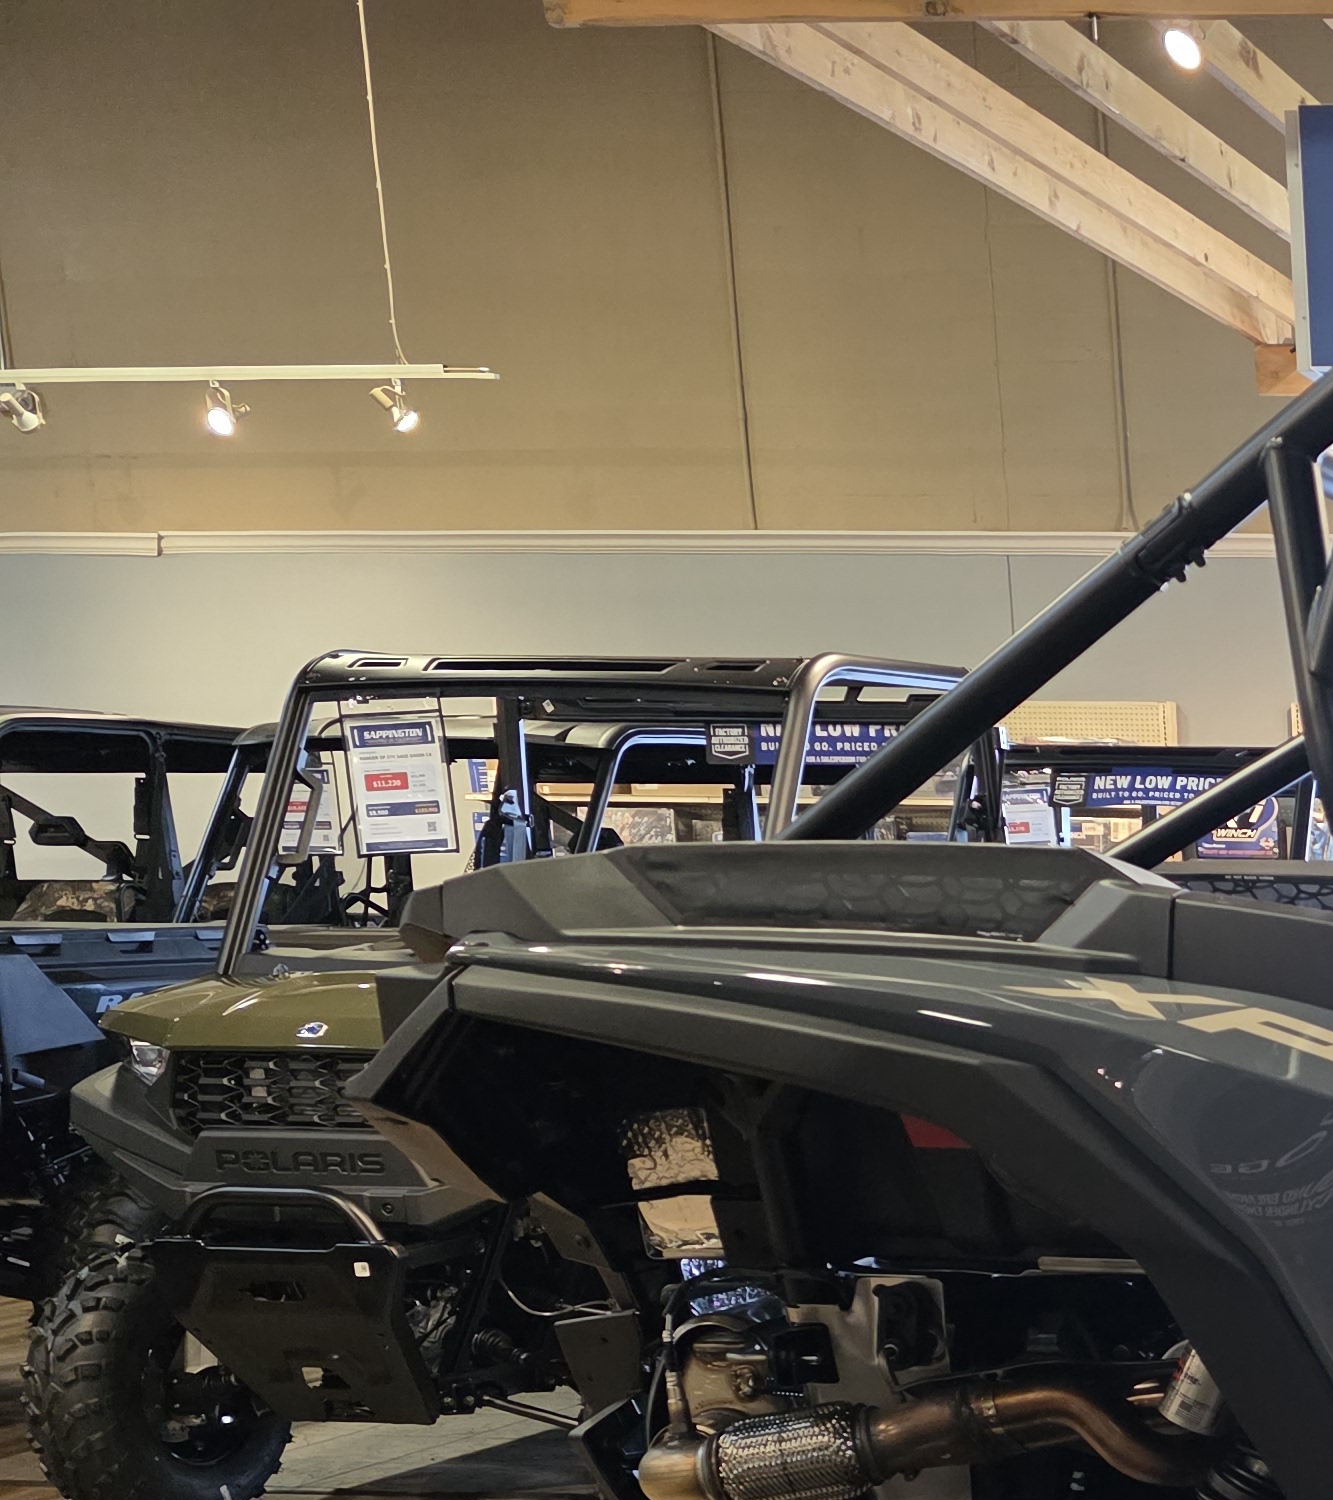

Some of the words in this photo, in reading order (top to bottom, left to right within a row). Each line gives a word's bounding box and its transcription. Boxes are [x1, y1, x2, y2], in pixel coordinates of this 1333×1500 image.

[364, 728, 422, 739] SAPPINGTON
[837, 742, 877, 750] PRICED
[1094, 776, 1131, 789] NEW
[1135, 776, 1172, 789] LOW
[1216, 829, 1257, 838] WINCH
[216, 1150, 385, 1175] POLARIS
